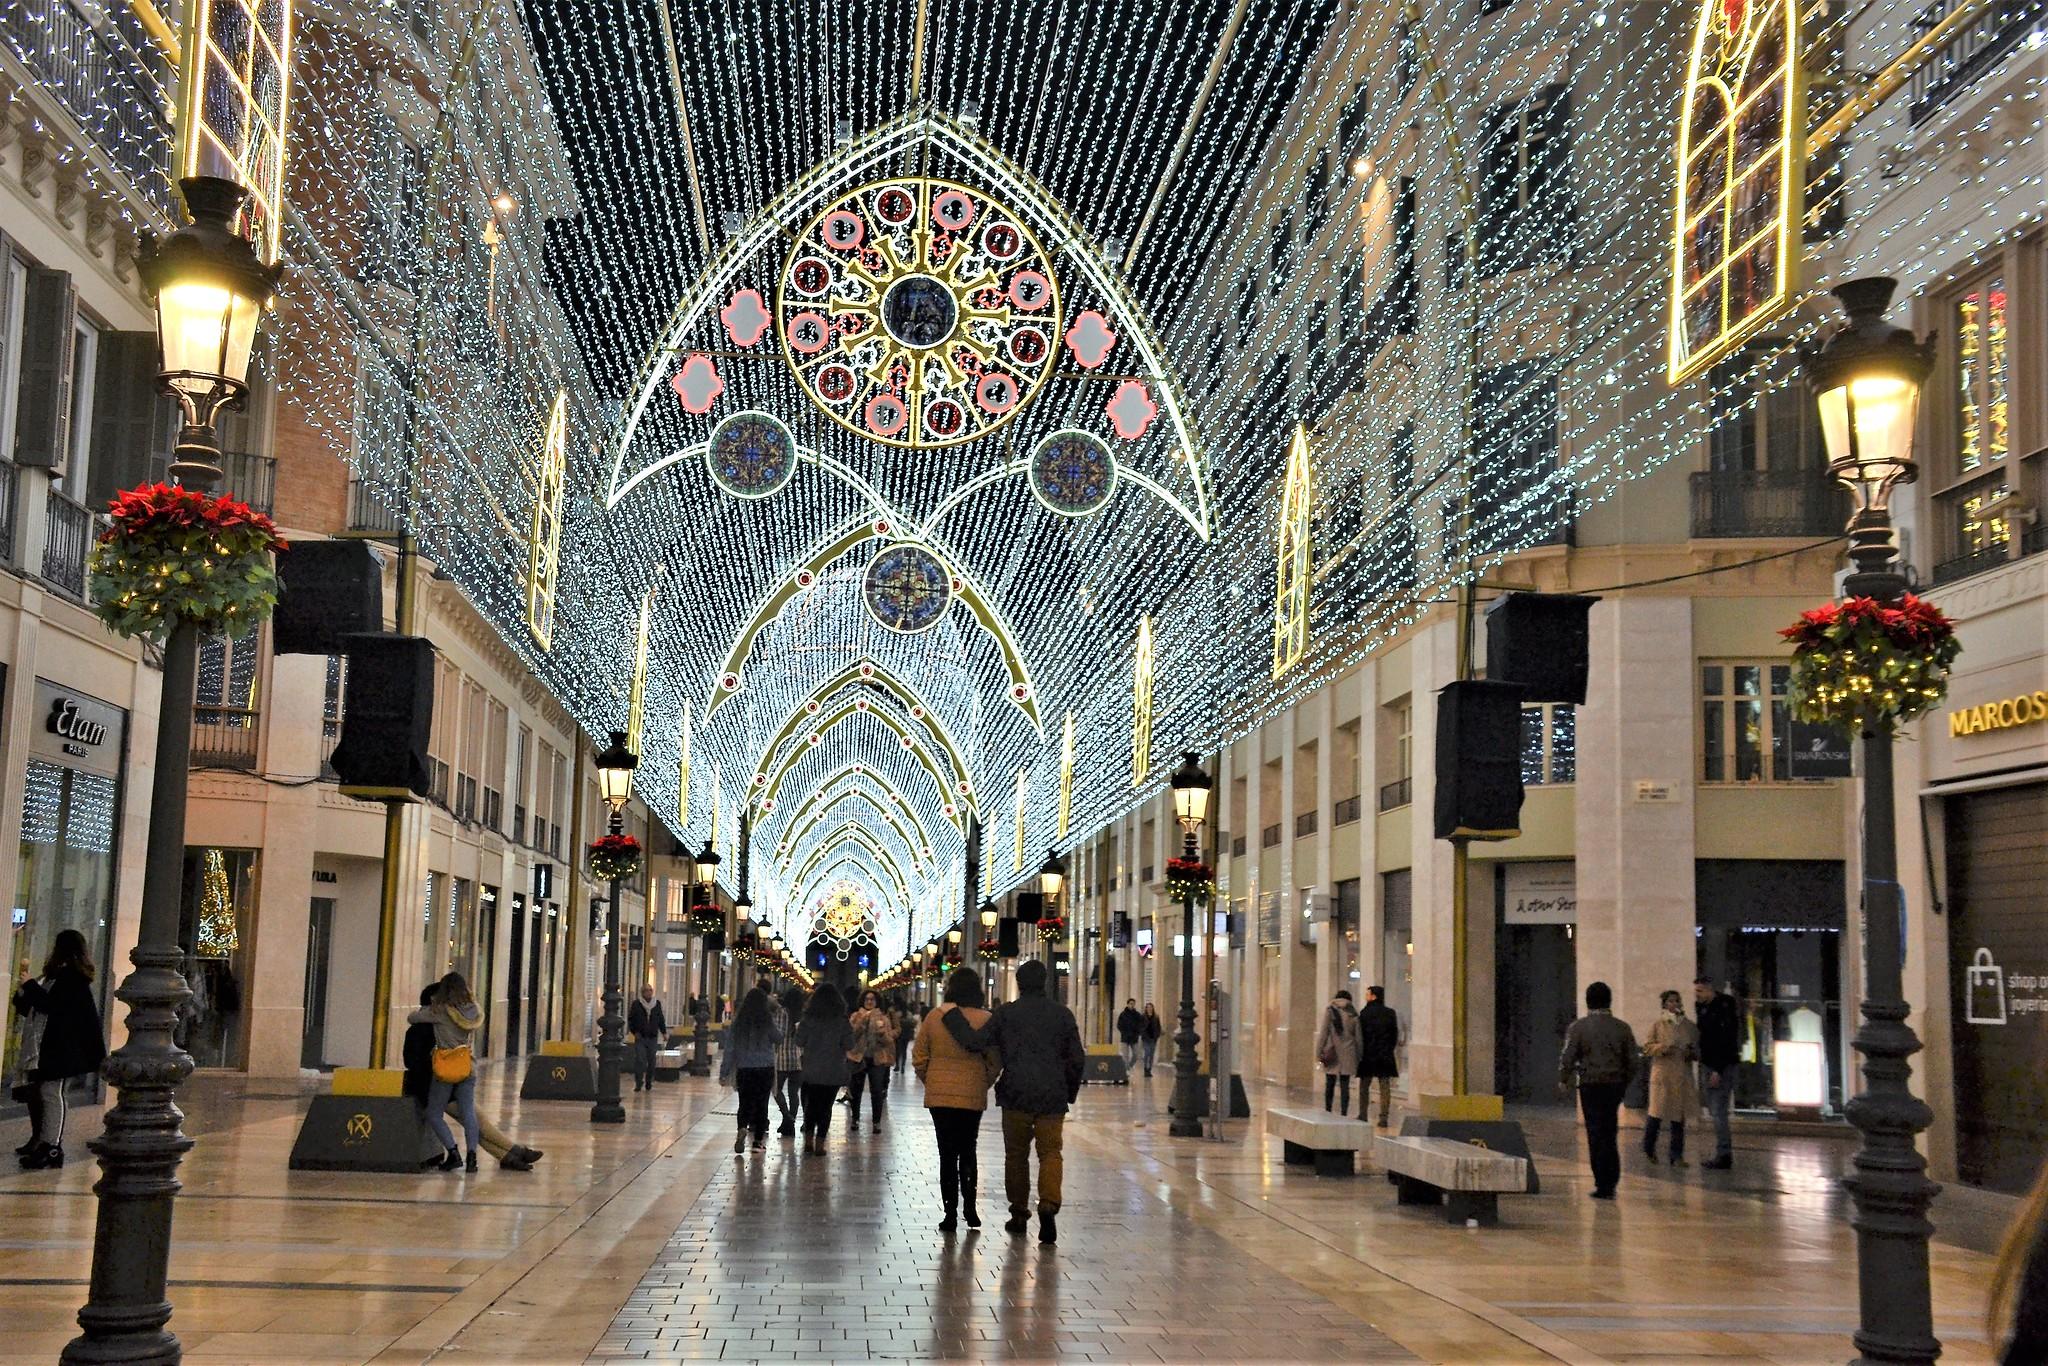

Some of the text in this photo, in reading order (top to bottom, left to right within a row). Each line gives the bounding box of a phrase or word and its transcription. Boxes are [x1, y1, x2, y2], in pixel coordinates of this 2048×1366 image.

[56, 699, 108, 745] Etam
[1949, 690, 2048, 738] MARCOS
[68, 744, 90, 758] PARIS
[2007, 971, 2037, 992] shop
